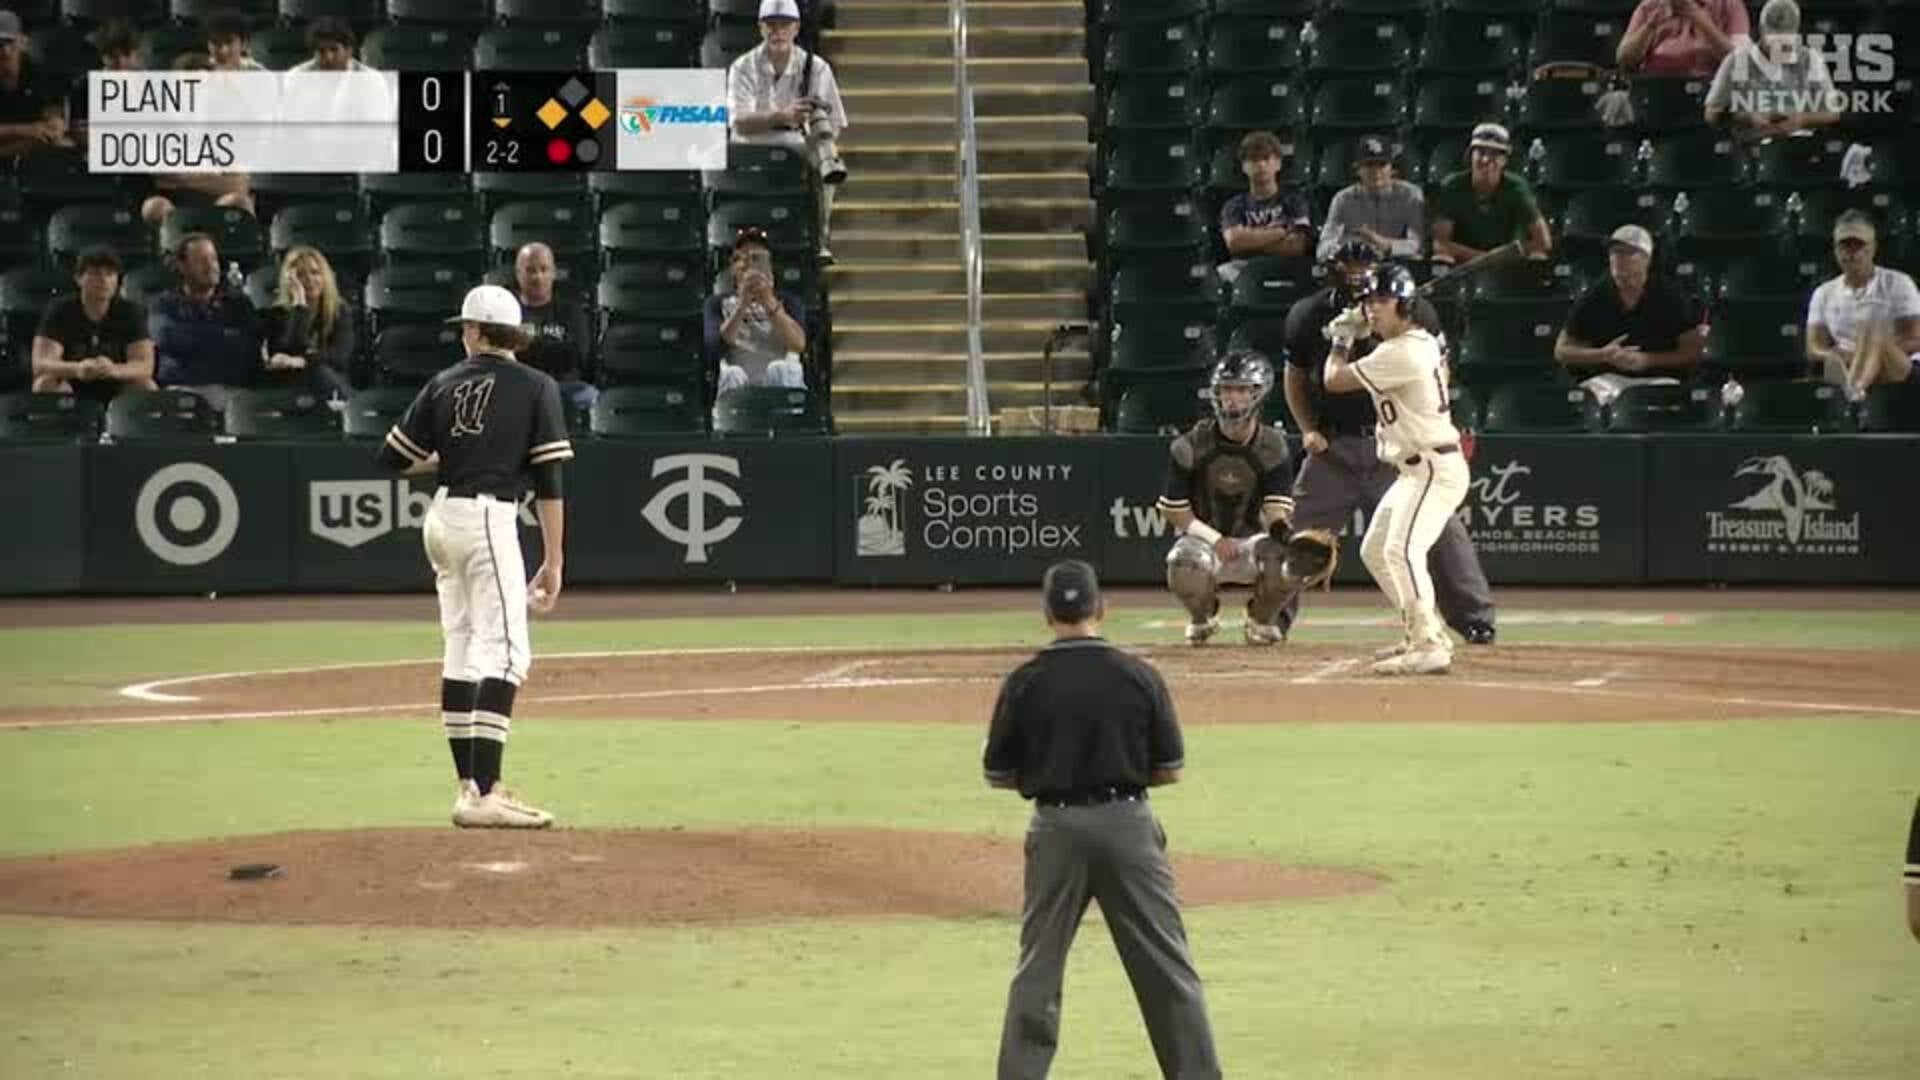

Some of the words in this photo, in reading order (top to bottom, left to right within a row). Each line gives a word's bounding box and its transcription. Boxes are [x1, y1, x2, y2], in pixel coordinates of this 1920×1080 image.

[451, 376, 496, 436] 11
[925, 466, 961, 481] LEE
[975, 465, 1073, 481] COUNTY
[1471, 460, 1531, 505] rt
[318, 493, 383, 529] us
[397, 480, 538, 529] bk
[923, 487, 1039, 523] Sports
[923, 519, 1081, 554] Complex
[1706, 512, 1785, 539] Treasure
[1803, 512, 1860, 540] Island
